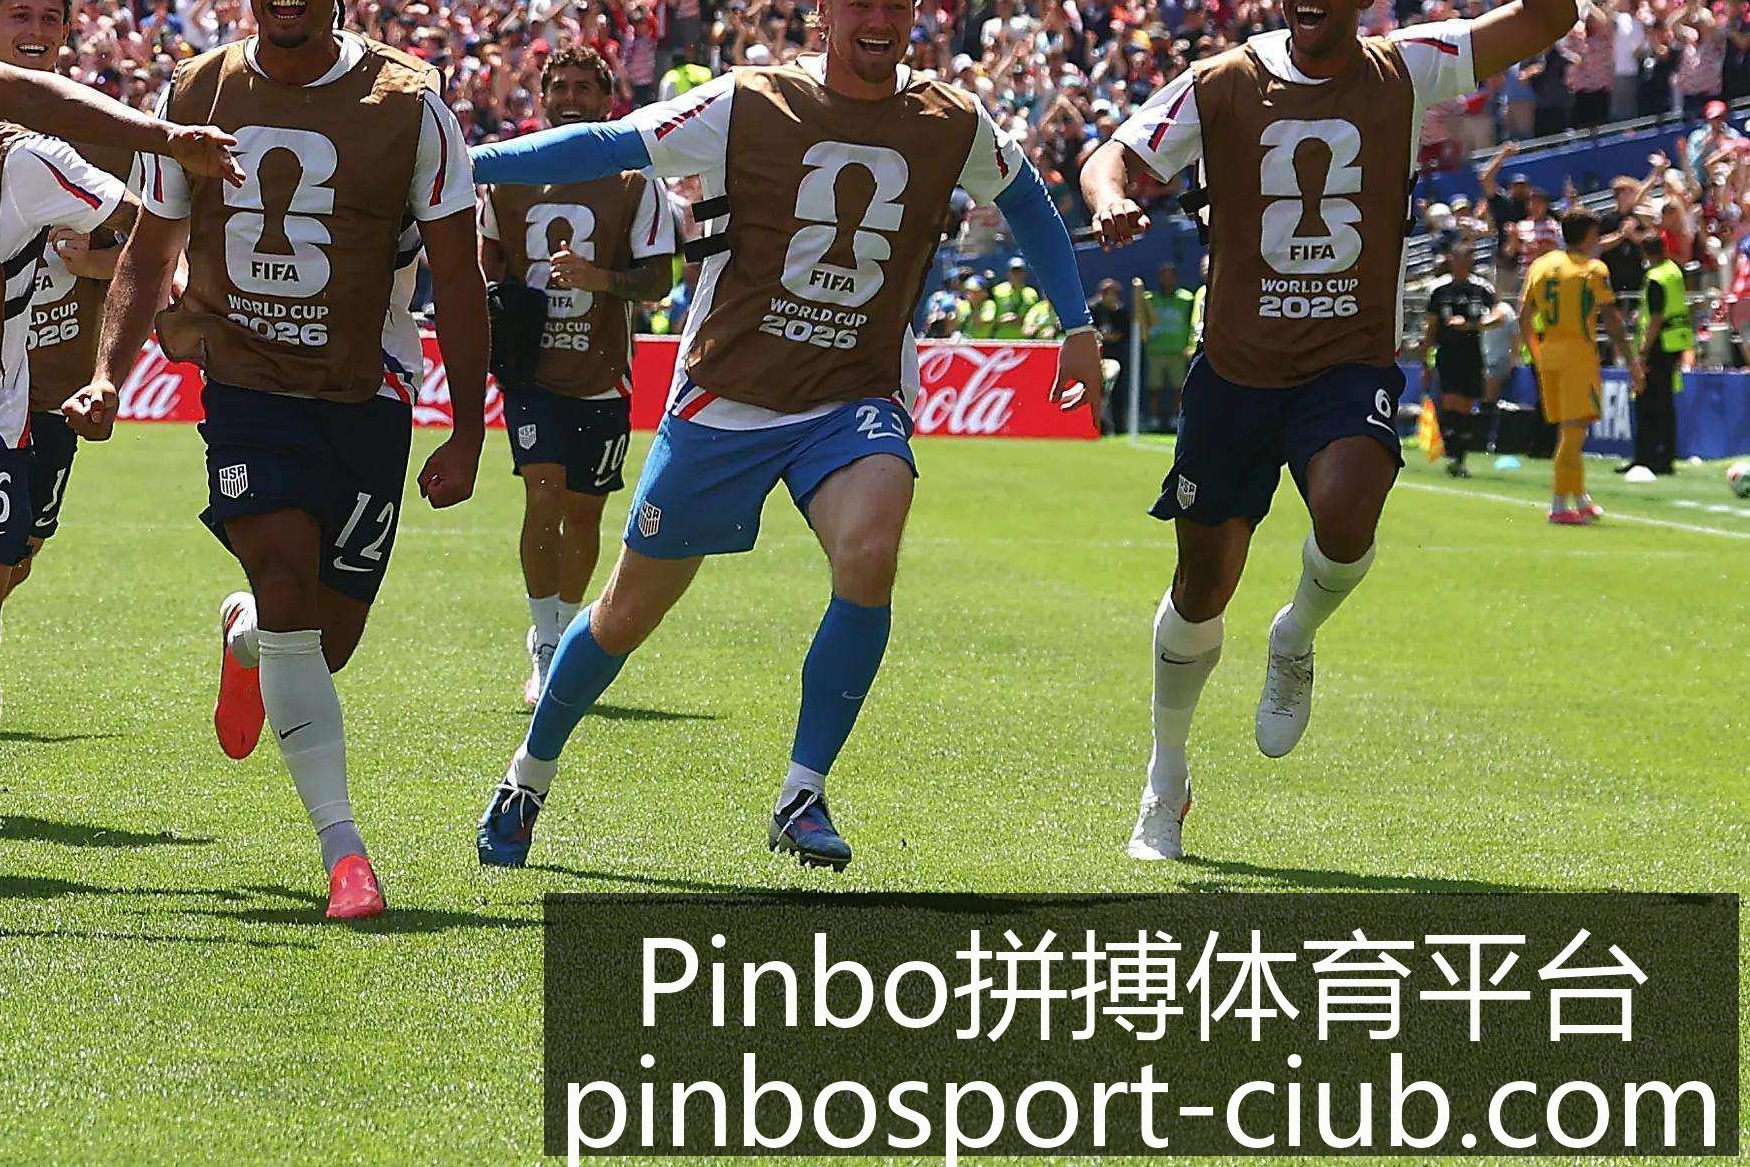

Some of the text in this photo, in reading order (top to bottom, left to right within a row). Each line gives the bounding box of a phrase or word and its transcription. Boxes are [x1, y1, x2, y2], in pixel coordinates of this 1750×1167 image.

[1290, 244, 1335, 261] FIFA
[251, 261, 300, 282] FIFA
[808, 269, 855, 293] FIFA
[1261, 278, 1359, 293] WORLD CUP
[51, 302, 79, 320] CUP
[227, 294, 329, 319] WORLD CUP
[771, 298, 868, 327] WORLD CUP
[1259, 295, 1359, 318] 2026
[1544, 278, 1560, 326] 5
[566, 322, 591, 332] CUP
[758, 315, 858, 349] 2026
[1374, 388, 1393, 419] 6
[596, 434, 626, 475] 10
[220, 465, 245, 480] USA
[335, 492, 394, 561] 12
